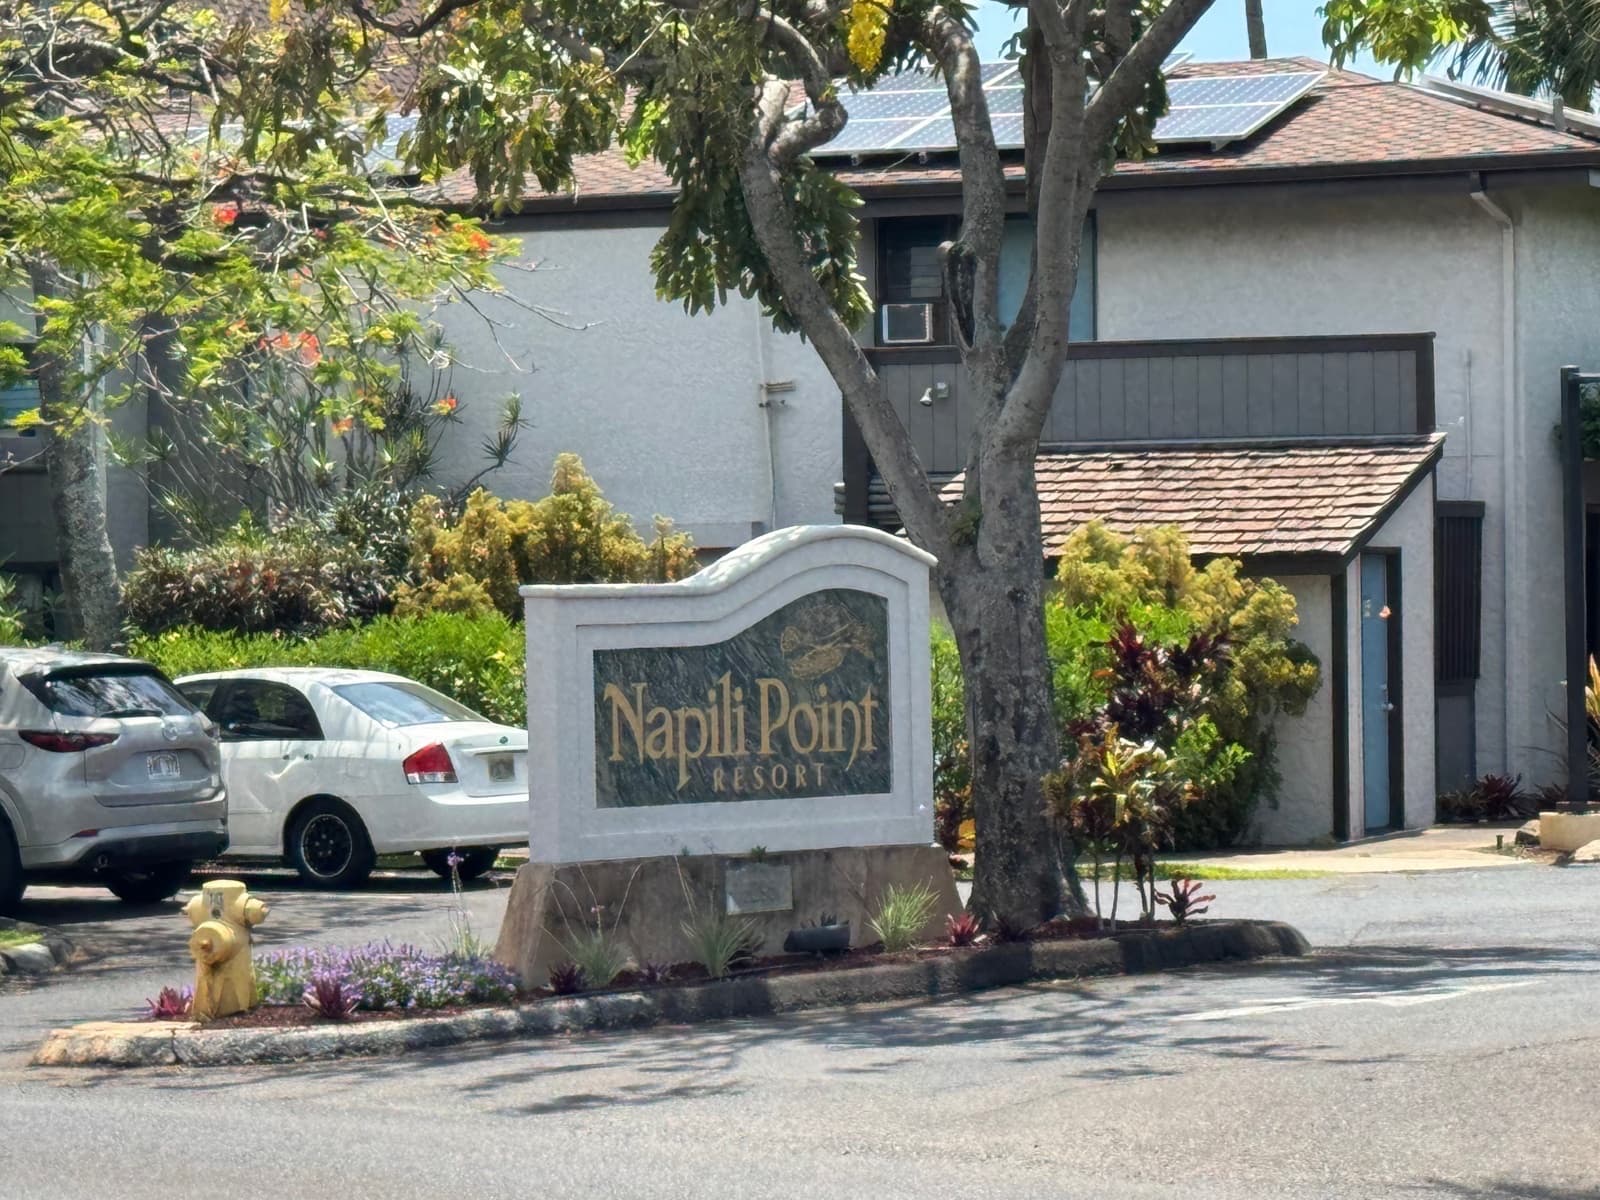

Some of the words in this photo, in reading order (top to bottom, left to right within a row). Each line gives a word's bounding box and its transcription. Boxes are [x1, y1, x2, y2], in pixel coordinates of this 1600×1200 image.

[603, 670, 749, 790] Napili
[756, 678, 879, 771] Point
[712, 762, 825, 792] RESORT
